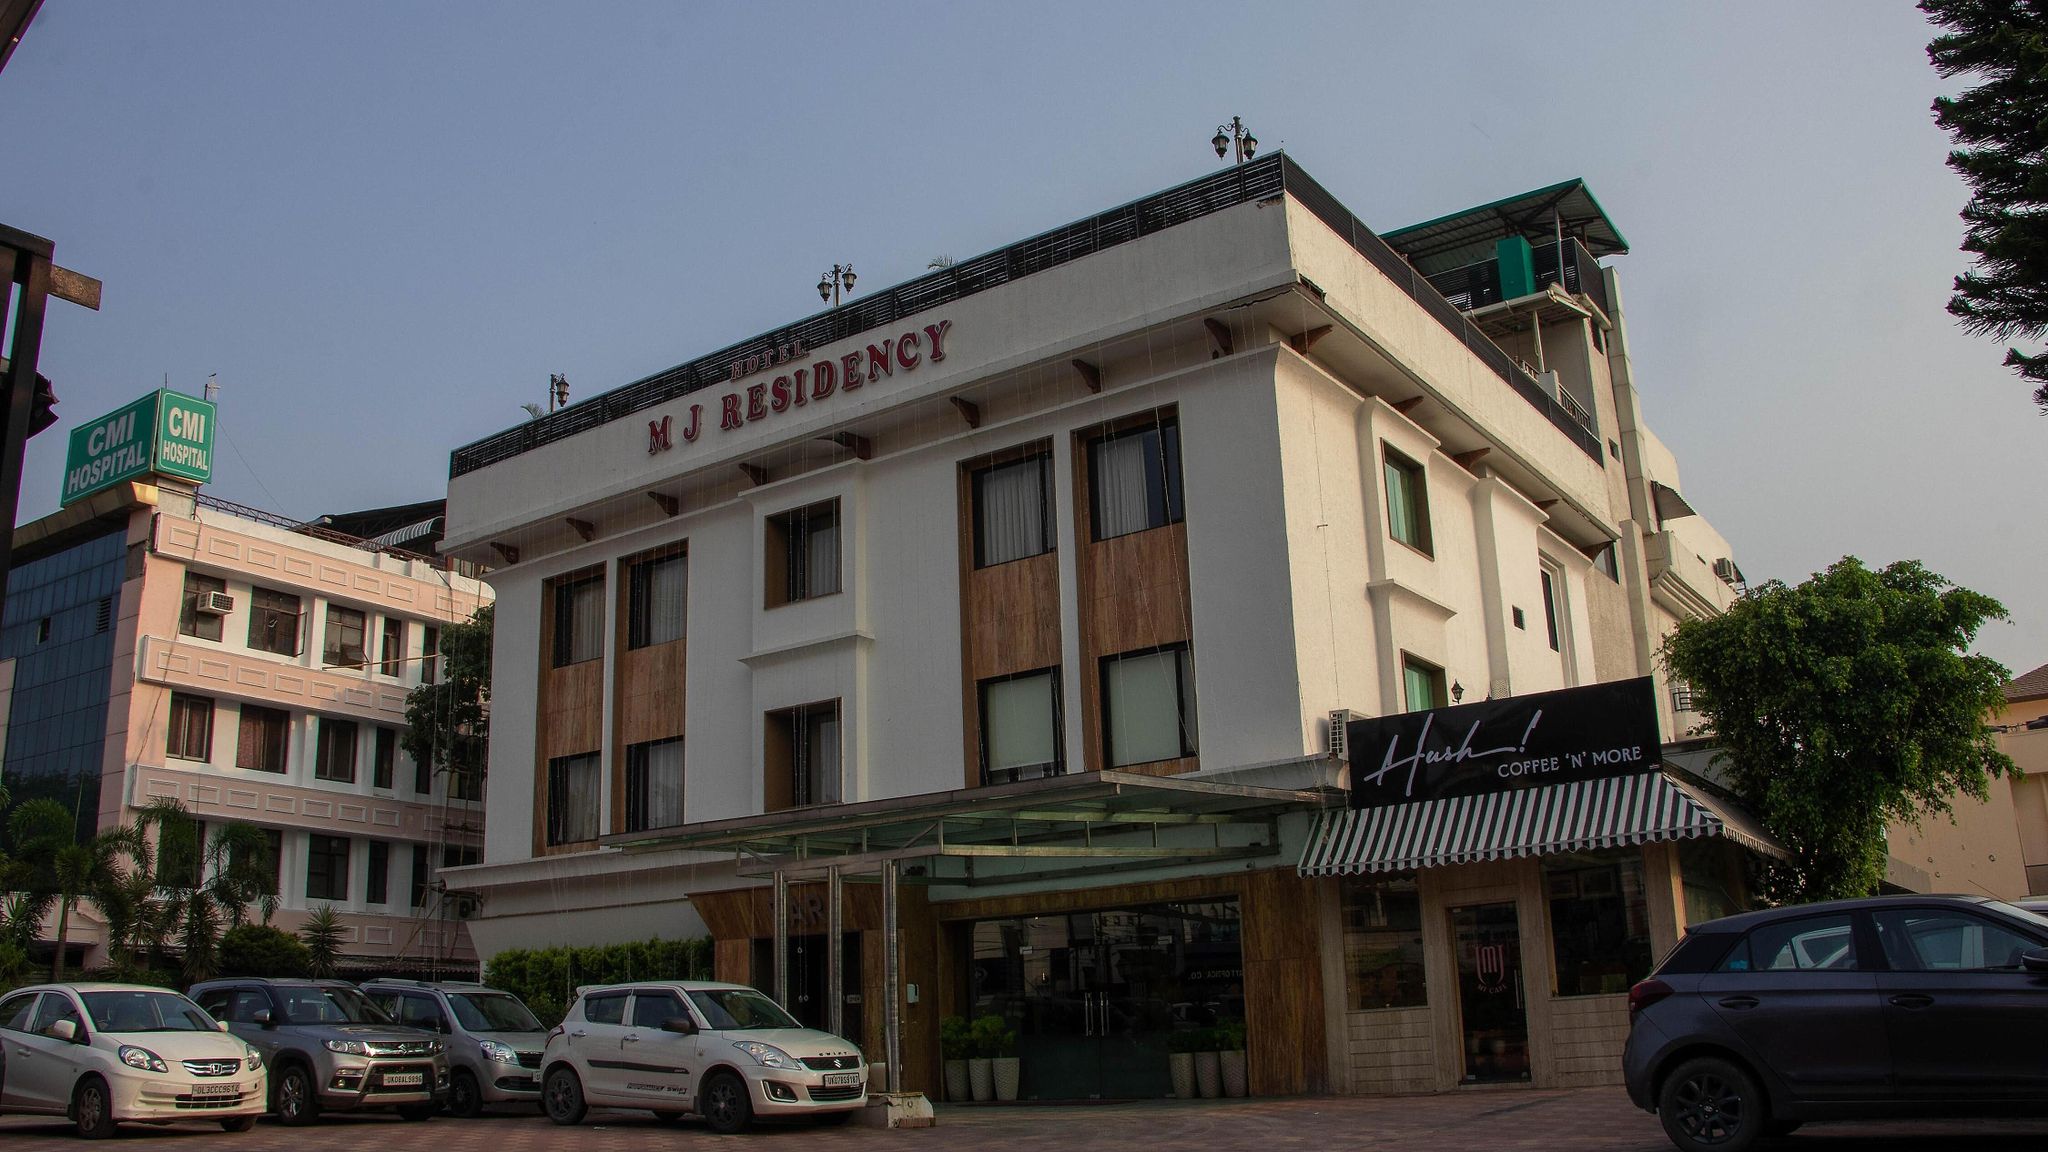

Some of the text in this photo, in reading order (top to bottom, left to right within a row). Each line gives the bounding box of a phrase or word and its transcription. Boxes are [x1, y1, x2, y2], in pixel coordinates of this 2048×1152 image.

[730, 339, 811, 382] HOTEL
[647, 319, 953, 455] M J RESIDENCY
[88, 412, 136, 456] CMI
[169, 407, 205, 443] CMI
[68, 442, 145, 494] HOSPITAL
[163, 440, 208, 471] HOSPITAL
[1497, 757, 1560, 779] COFFEE
[1591, 746, 1643, 767] MORE
